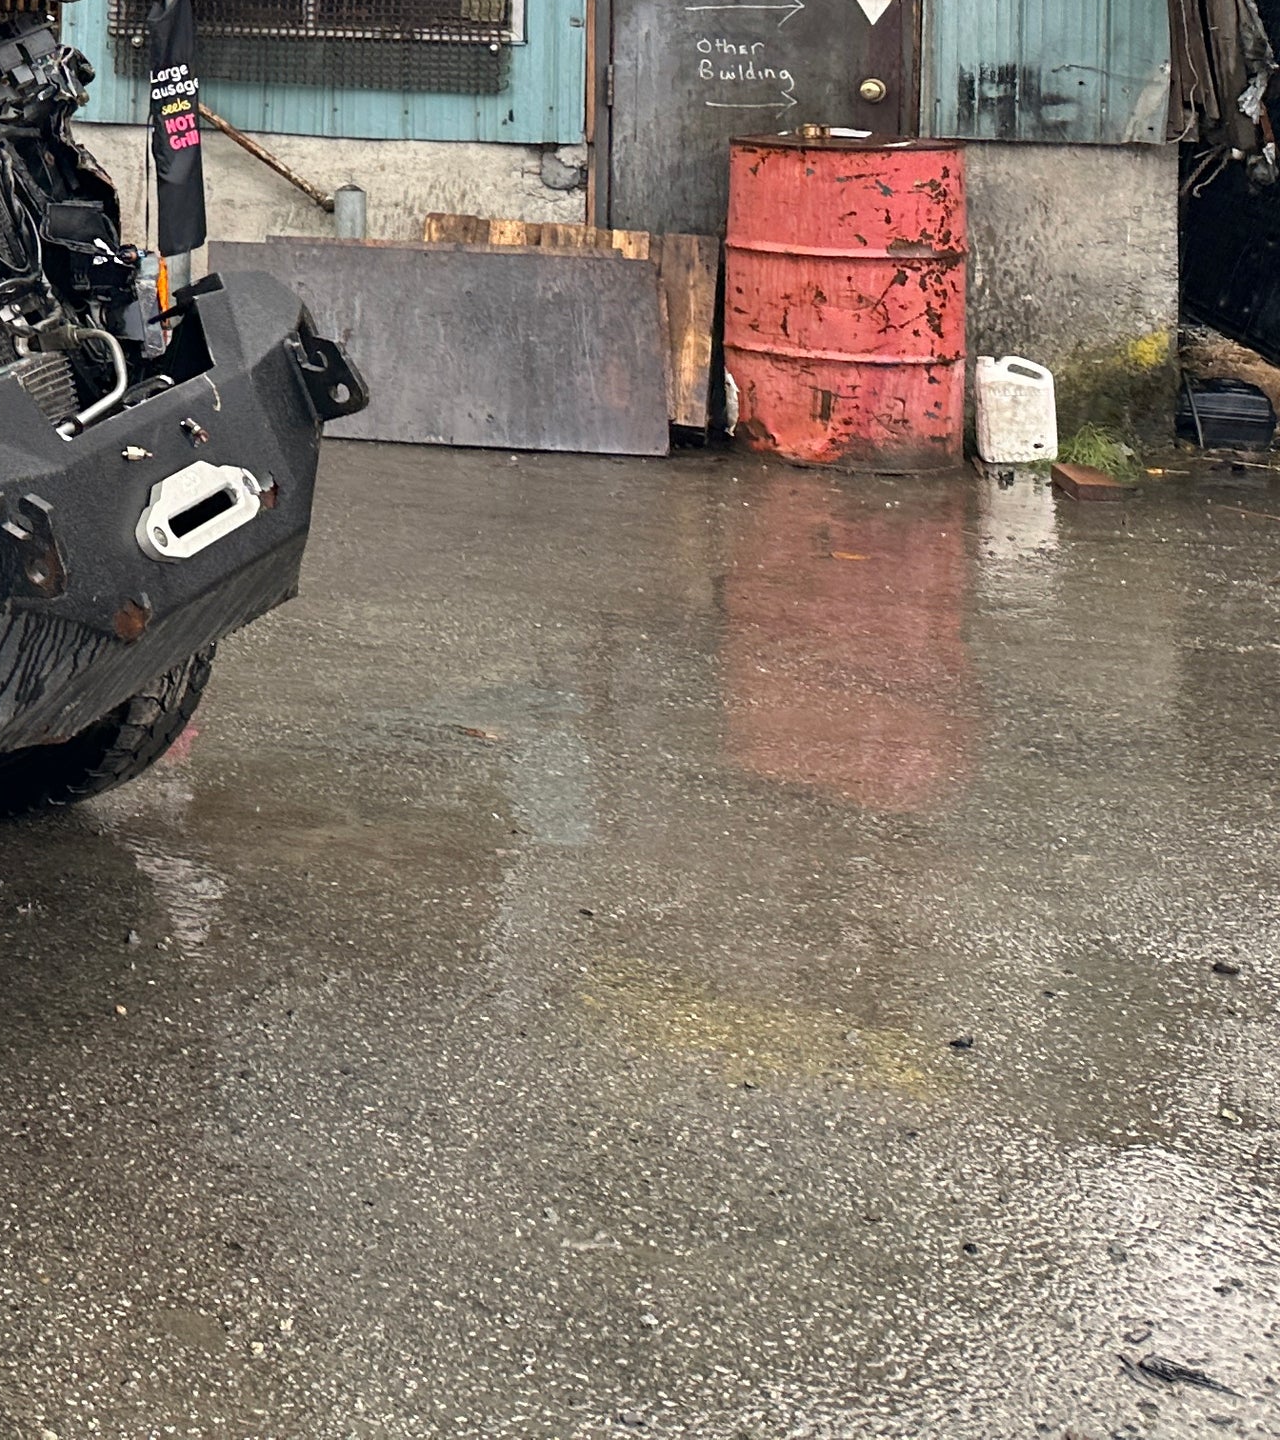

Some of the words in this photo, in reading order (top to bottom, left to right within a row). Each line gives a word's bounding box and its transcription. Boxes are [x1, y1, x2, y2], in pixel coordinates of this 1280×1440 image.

[695, 37, 765, 56] Other
[150, 64, 189, 84] Large
[698, 59, 796, 92] Building
[161, 97, 192, 116] seeks
[165, 113, 196, 134] HOT
[169, 129, 200, 150] Grill
